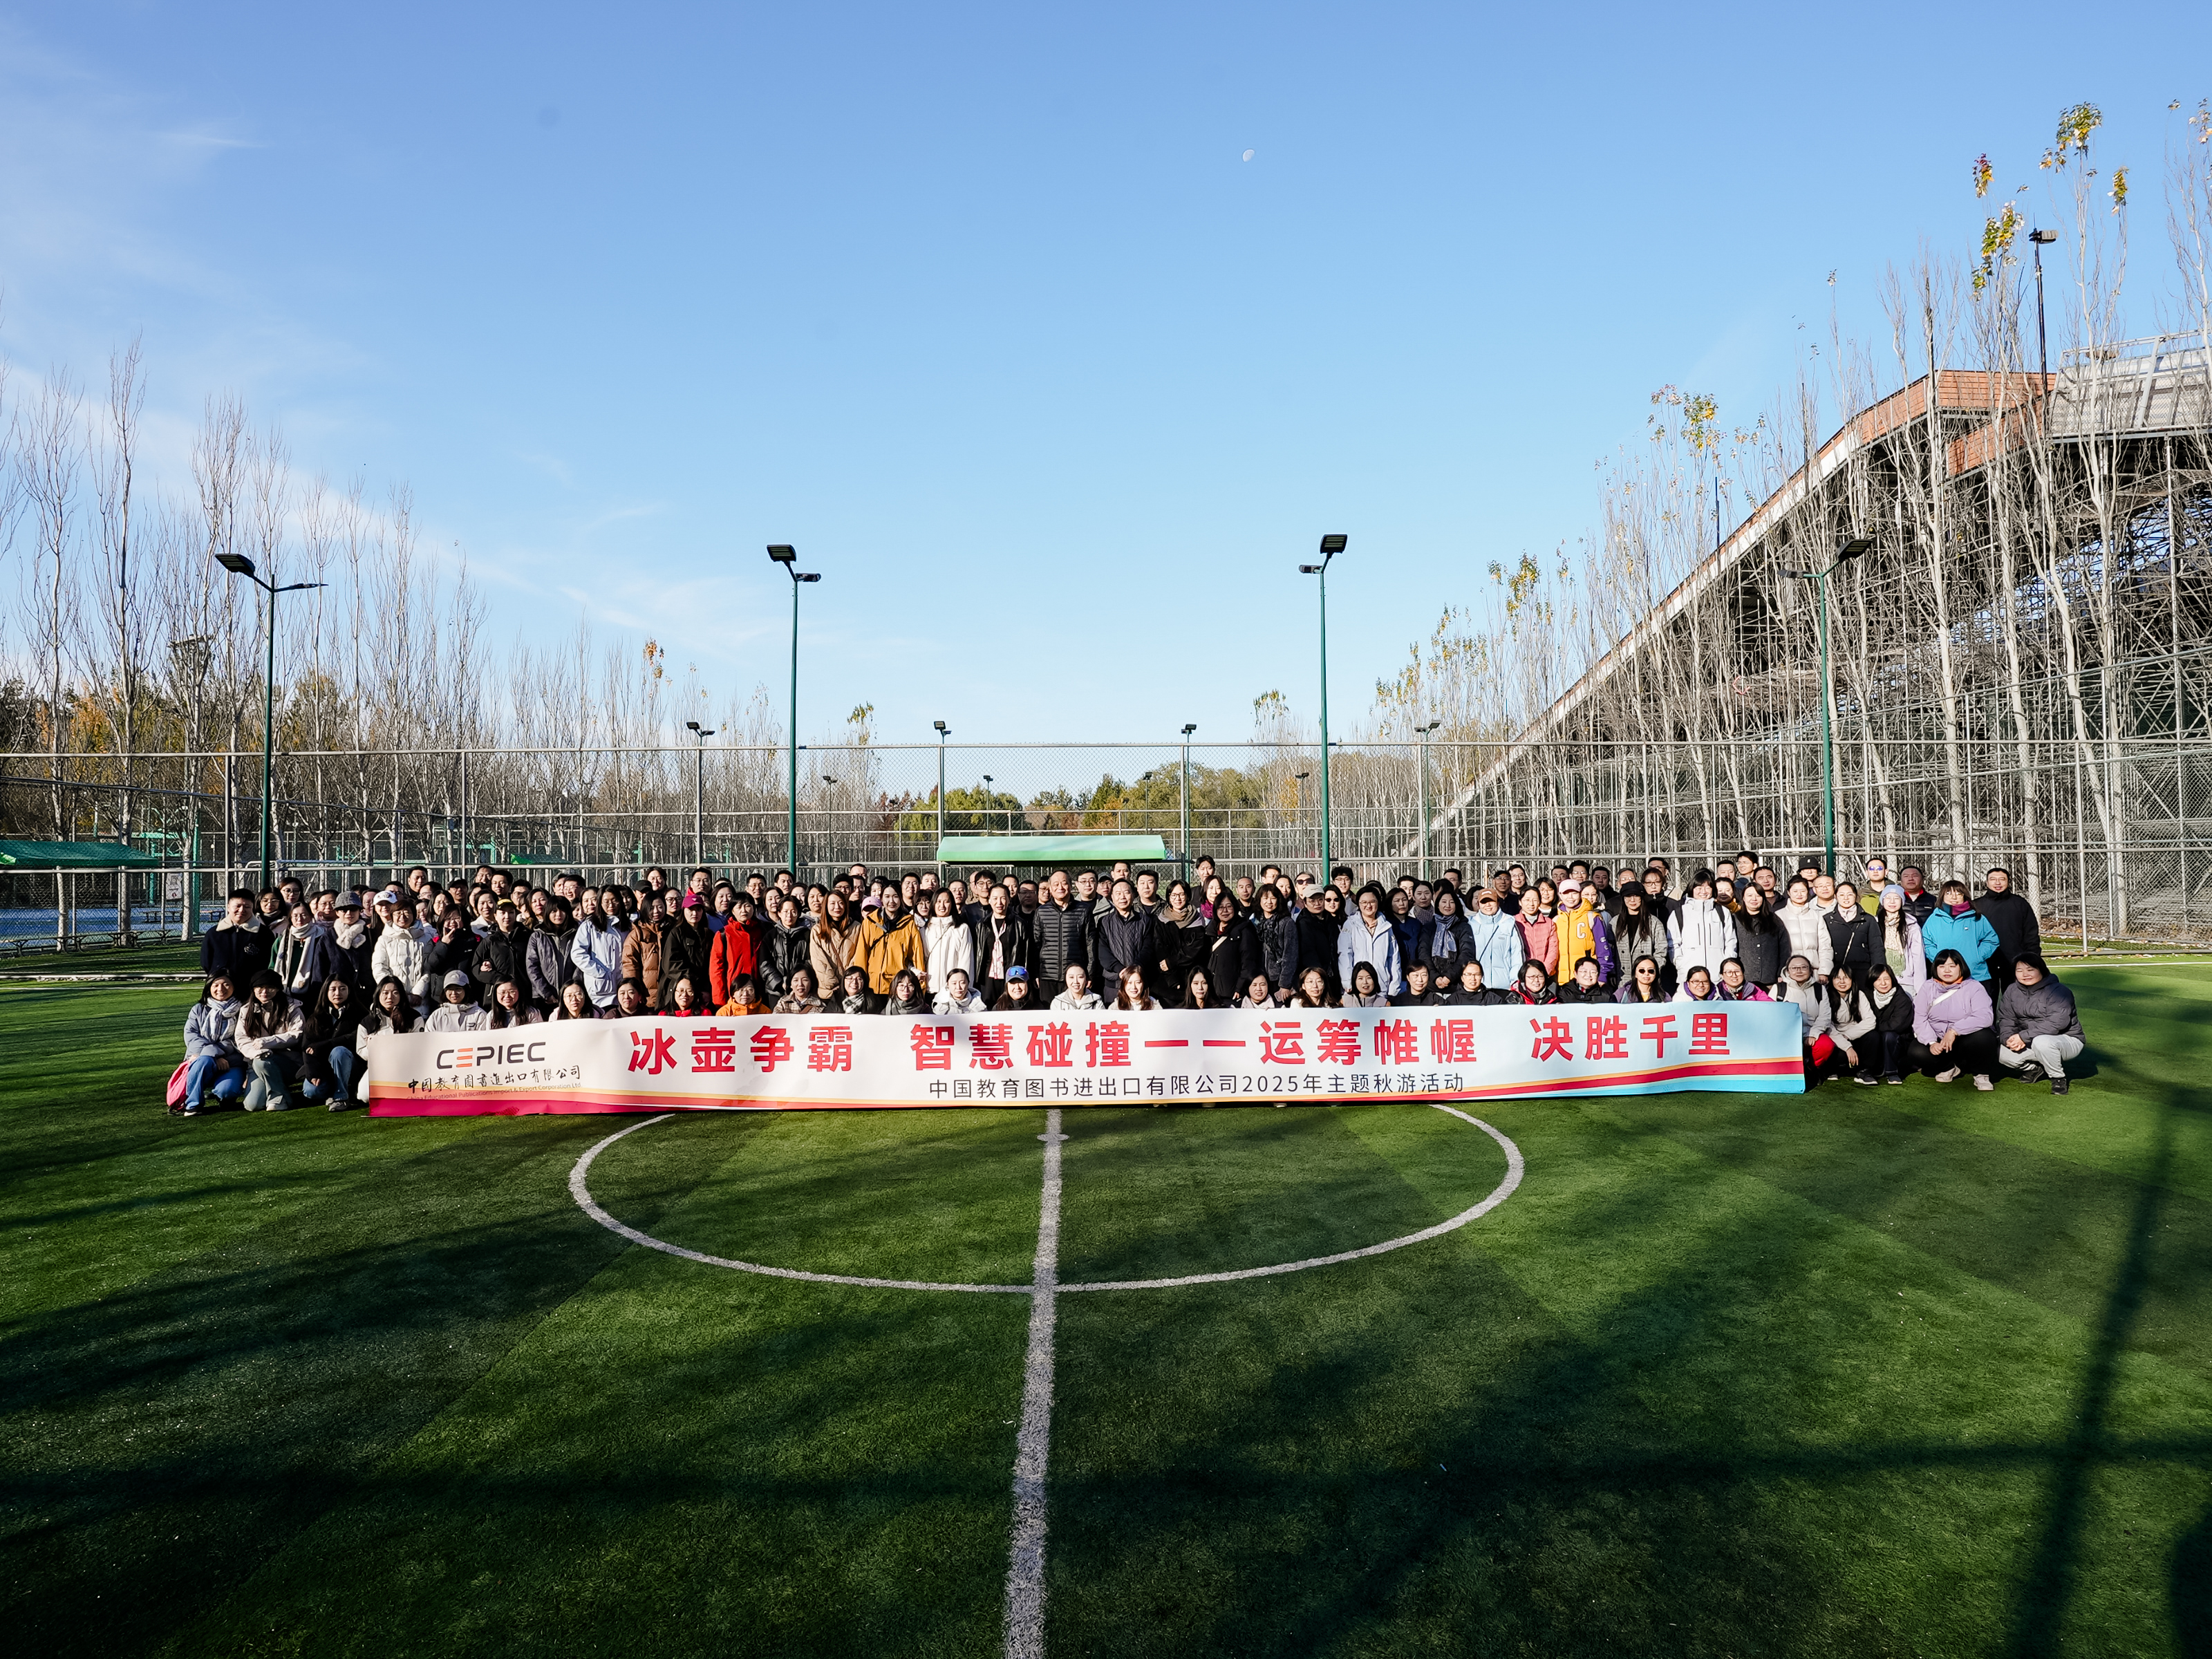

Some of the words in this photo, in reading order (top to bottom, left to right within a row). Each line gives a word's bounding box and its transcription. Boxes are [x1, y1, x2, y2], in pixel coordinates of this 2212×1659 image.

[1577, 922, 1586, 939] C
[437, 1042, 546, 1069] CEPIEC
[628, 1025, 853, 1076] 冰壶争霸
[1530, 1013, 1730, 1061] 决胜千里
[424, 1091, 458, 1100] Educational
[458, 1089, 493, 1098] Publications
[929, 1073, 1464, 1098] 中国教育图书进出口有限公司2025年主题秋游活动
